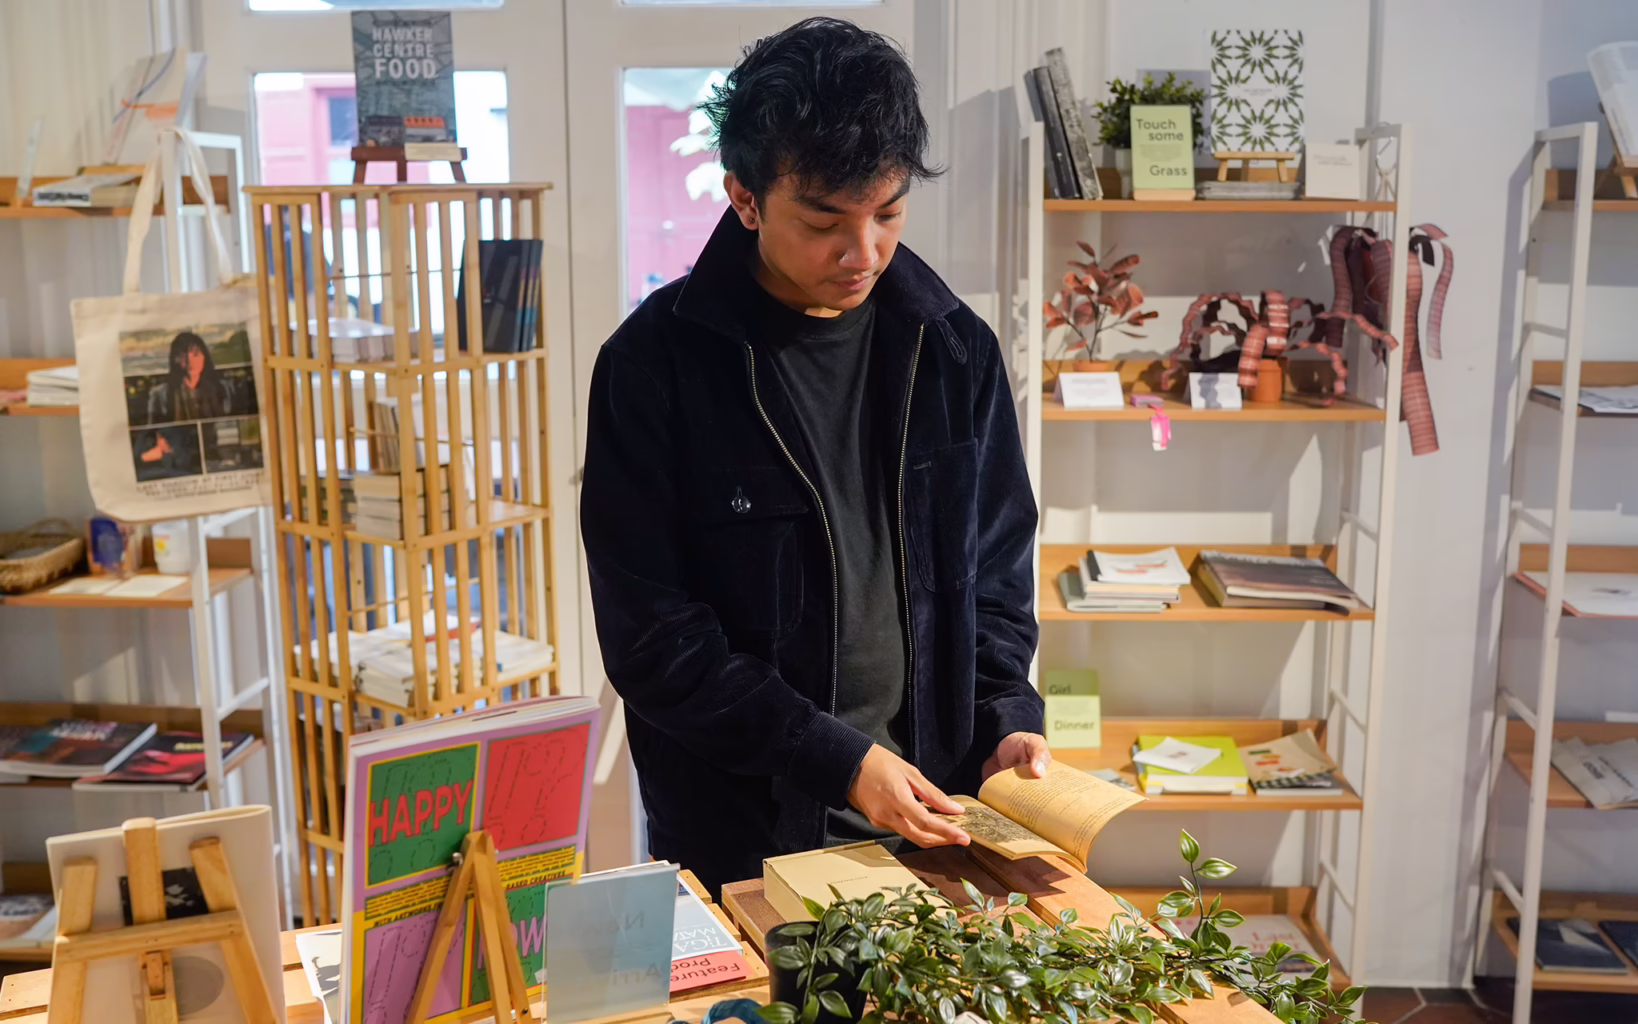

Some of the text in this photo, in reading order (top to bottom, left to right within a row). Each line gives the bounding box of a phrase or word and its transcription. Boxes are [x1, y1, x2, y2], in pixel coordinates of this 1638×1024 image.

[372, 27, 433, 42] HAWKER
[373, 43, 435, 58] CENTRE
[375, 58, 438, 80] FOOD
[1136, 118, 1177, 130] Touch
[1148, 132, 1184, 141] some
[1149, 164, 1188, 176] Grass
[1049, 683, 1072, 695] Girl
[1054, 720, 1095, 732] Dinner
[369, 780, 474, 848] HAPPY
[529, 870, 567, 884] CREATIVES
